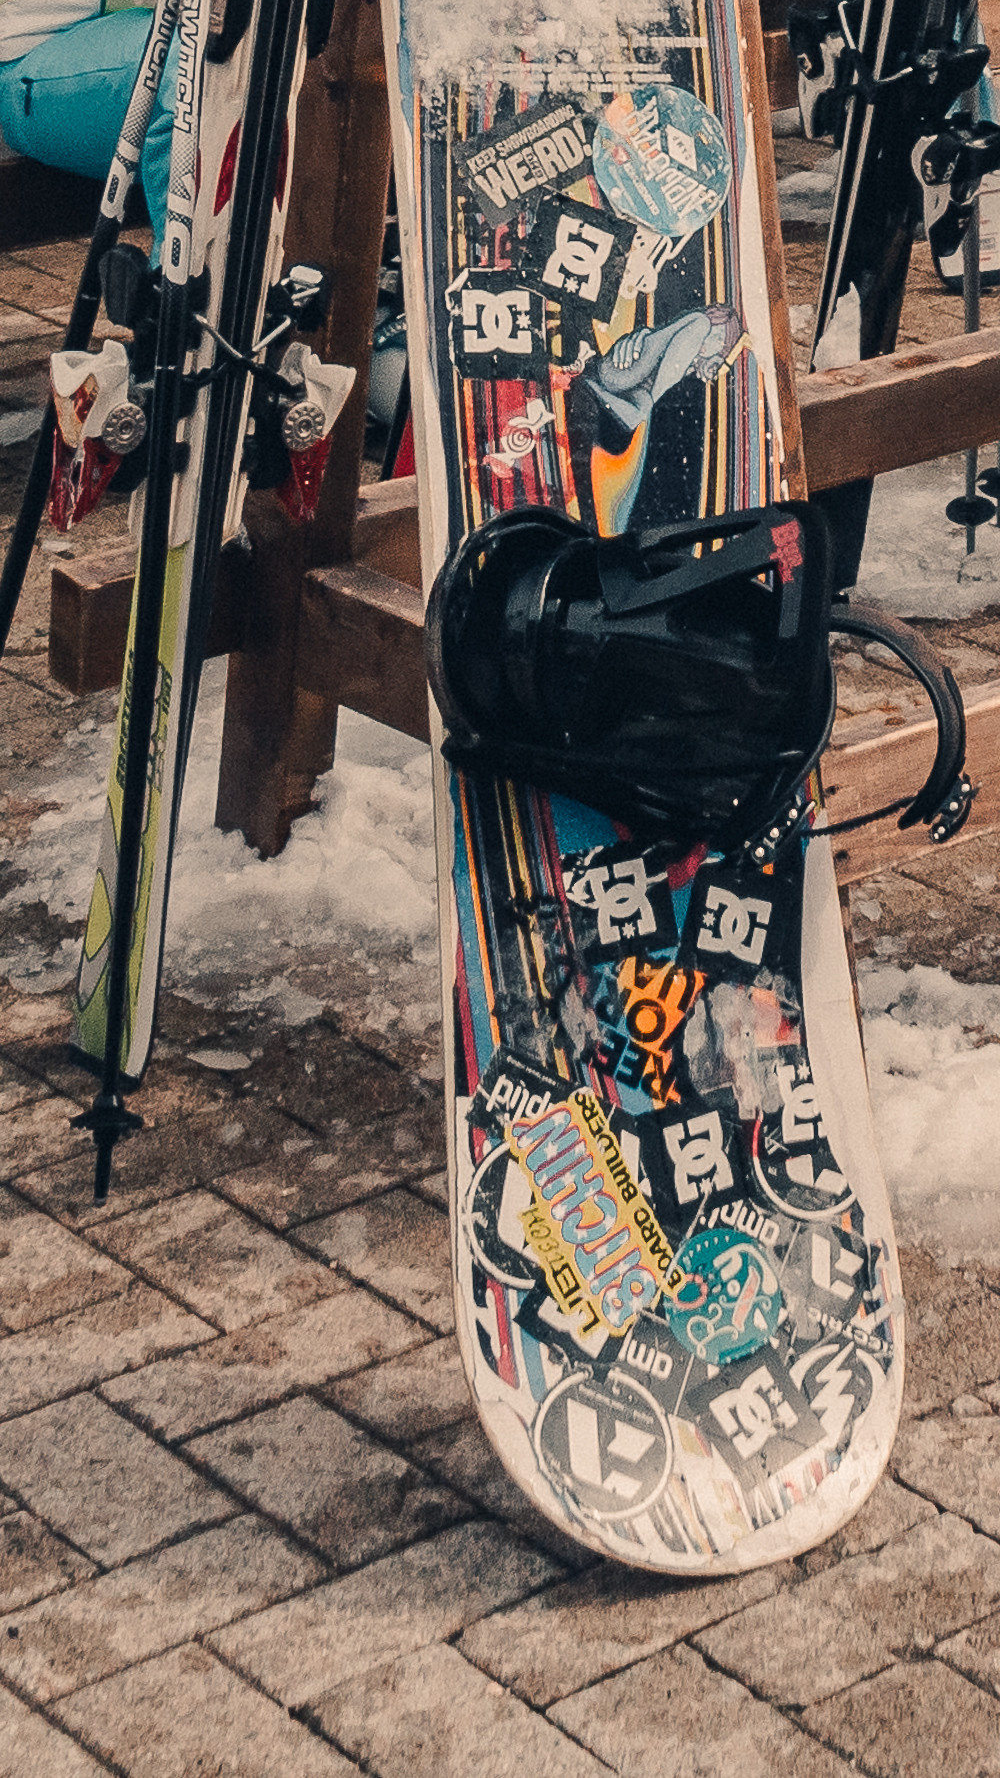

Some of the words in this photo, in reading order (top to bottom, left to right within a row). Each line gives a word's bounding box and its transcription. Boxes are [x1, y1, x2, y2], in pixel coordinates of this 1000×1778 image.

[465, 147, 498, 175] KEEP
[495, 104, 576, 159] SNOWBOARDING
[543, 214, 615, 302] DC
[461, 288, 533, 354] DC
[597, 857, 658, 945] DC
[696, 885, 773, 965] DC
[662, 1110, 734, 1205] DC
[708, 1366, 800, 1459] DC
